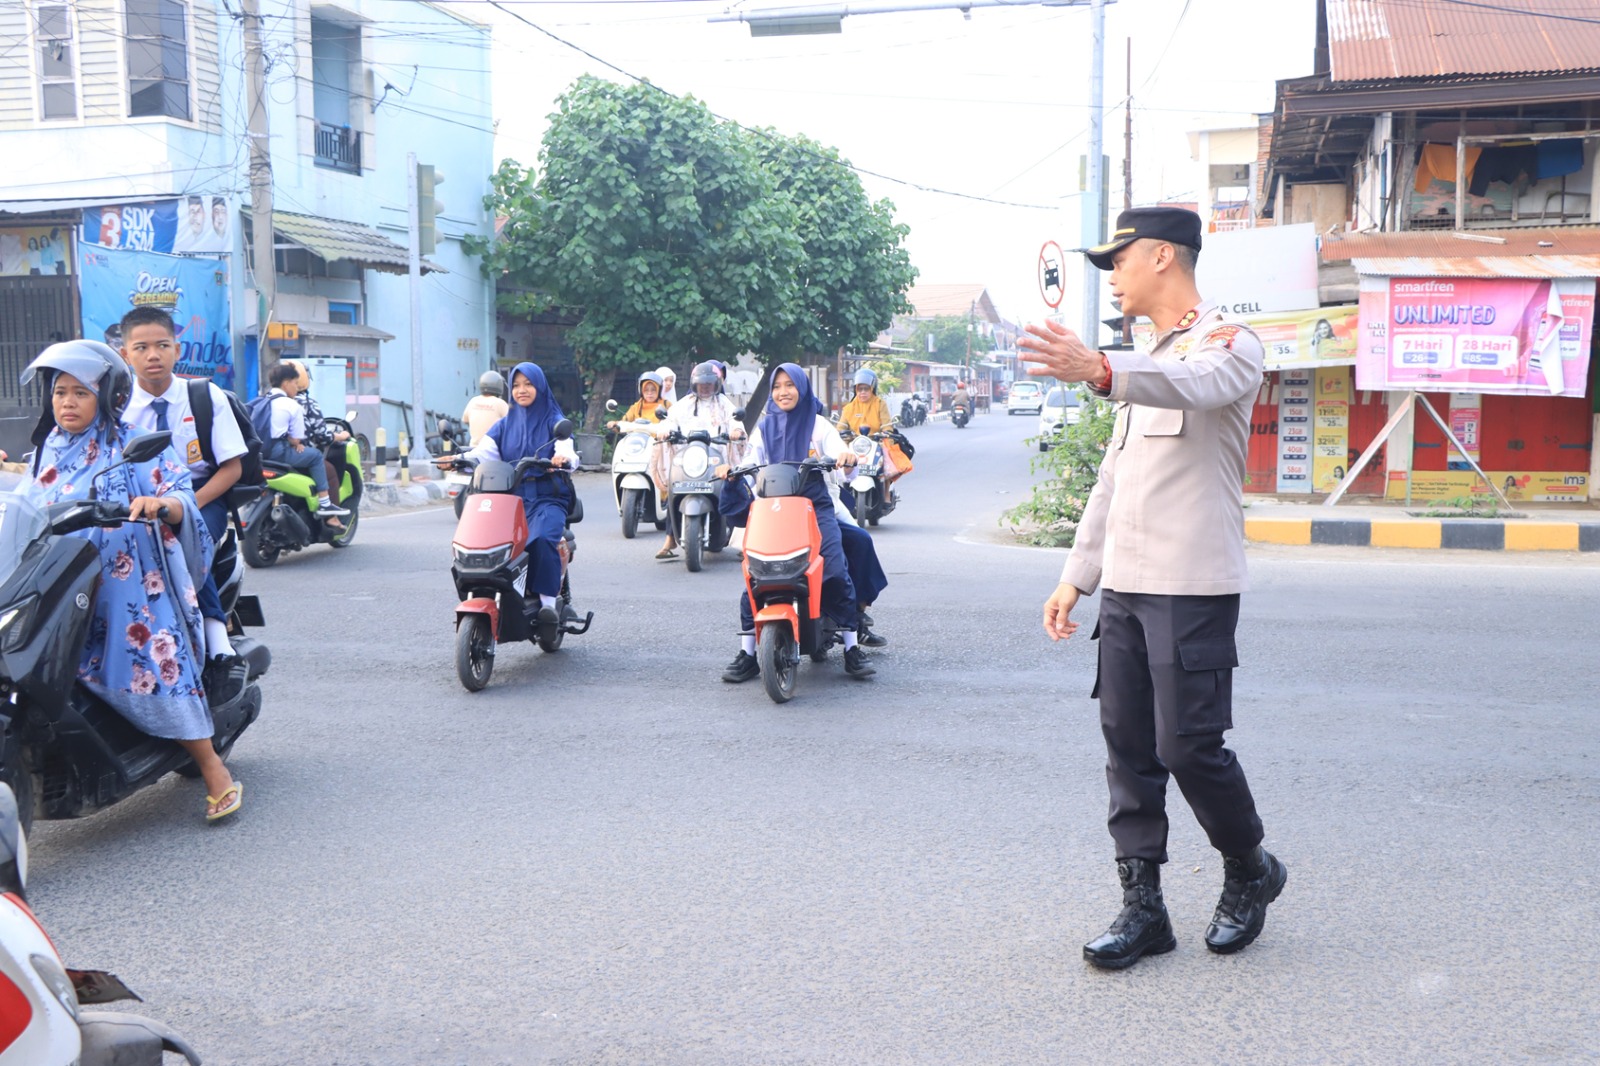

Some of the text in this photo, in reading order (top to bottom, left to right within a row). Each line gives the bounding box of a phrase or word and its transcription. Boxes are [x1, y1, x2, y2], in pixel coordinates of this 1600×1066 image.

[122, 207, 155, 231] SDK
[99, 212, 121, 248] 3
[1394, 281, 1454, 292] smartfren
[1233, 302, 1262, 314] CELL
[1394, 304, 1496, 325] UNLIMITED
[1403, 339, 1443, 350] 7 Hari
[1463, 340, 1512, 351] 28 Hari
